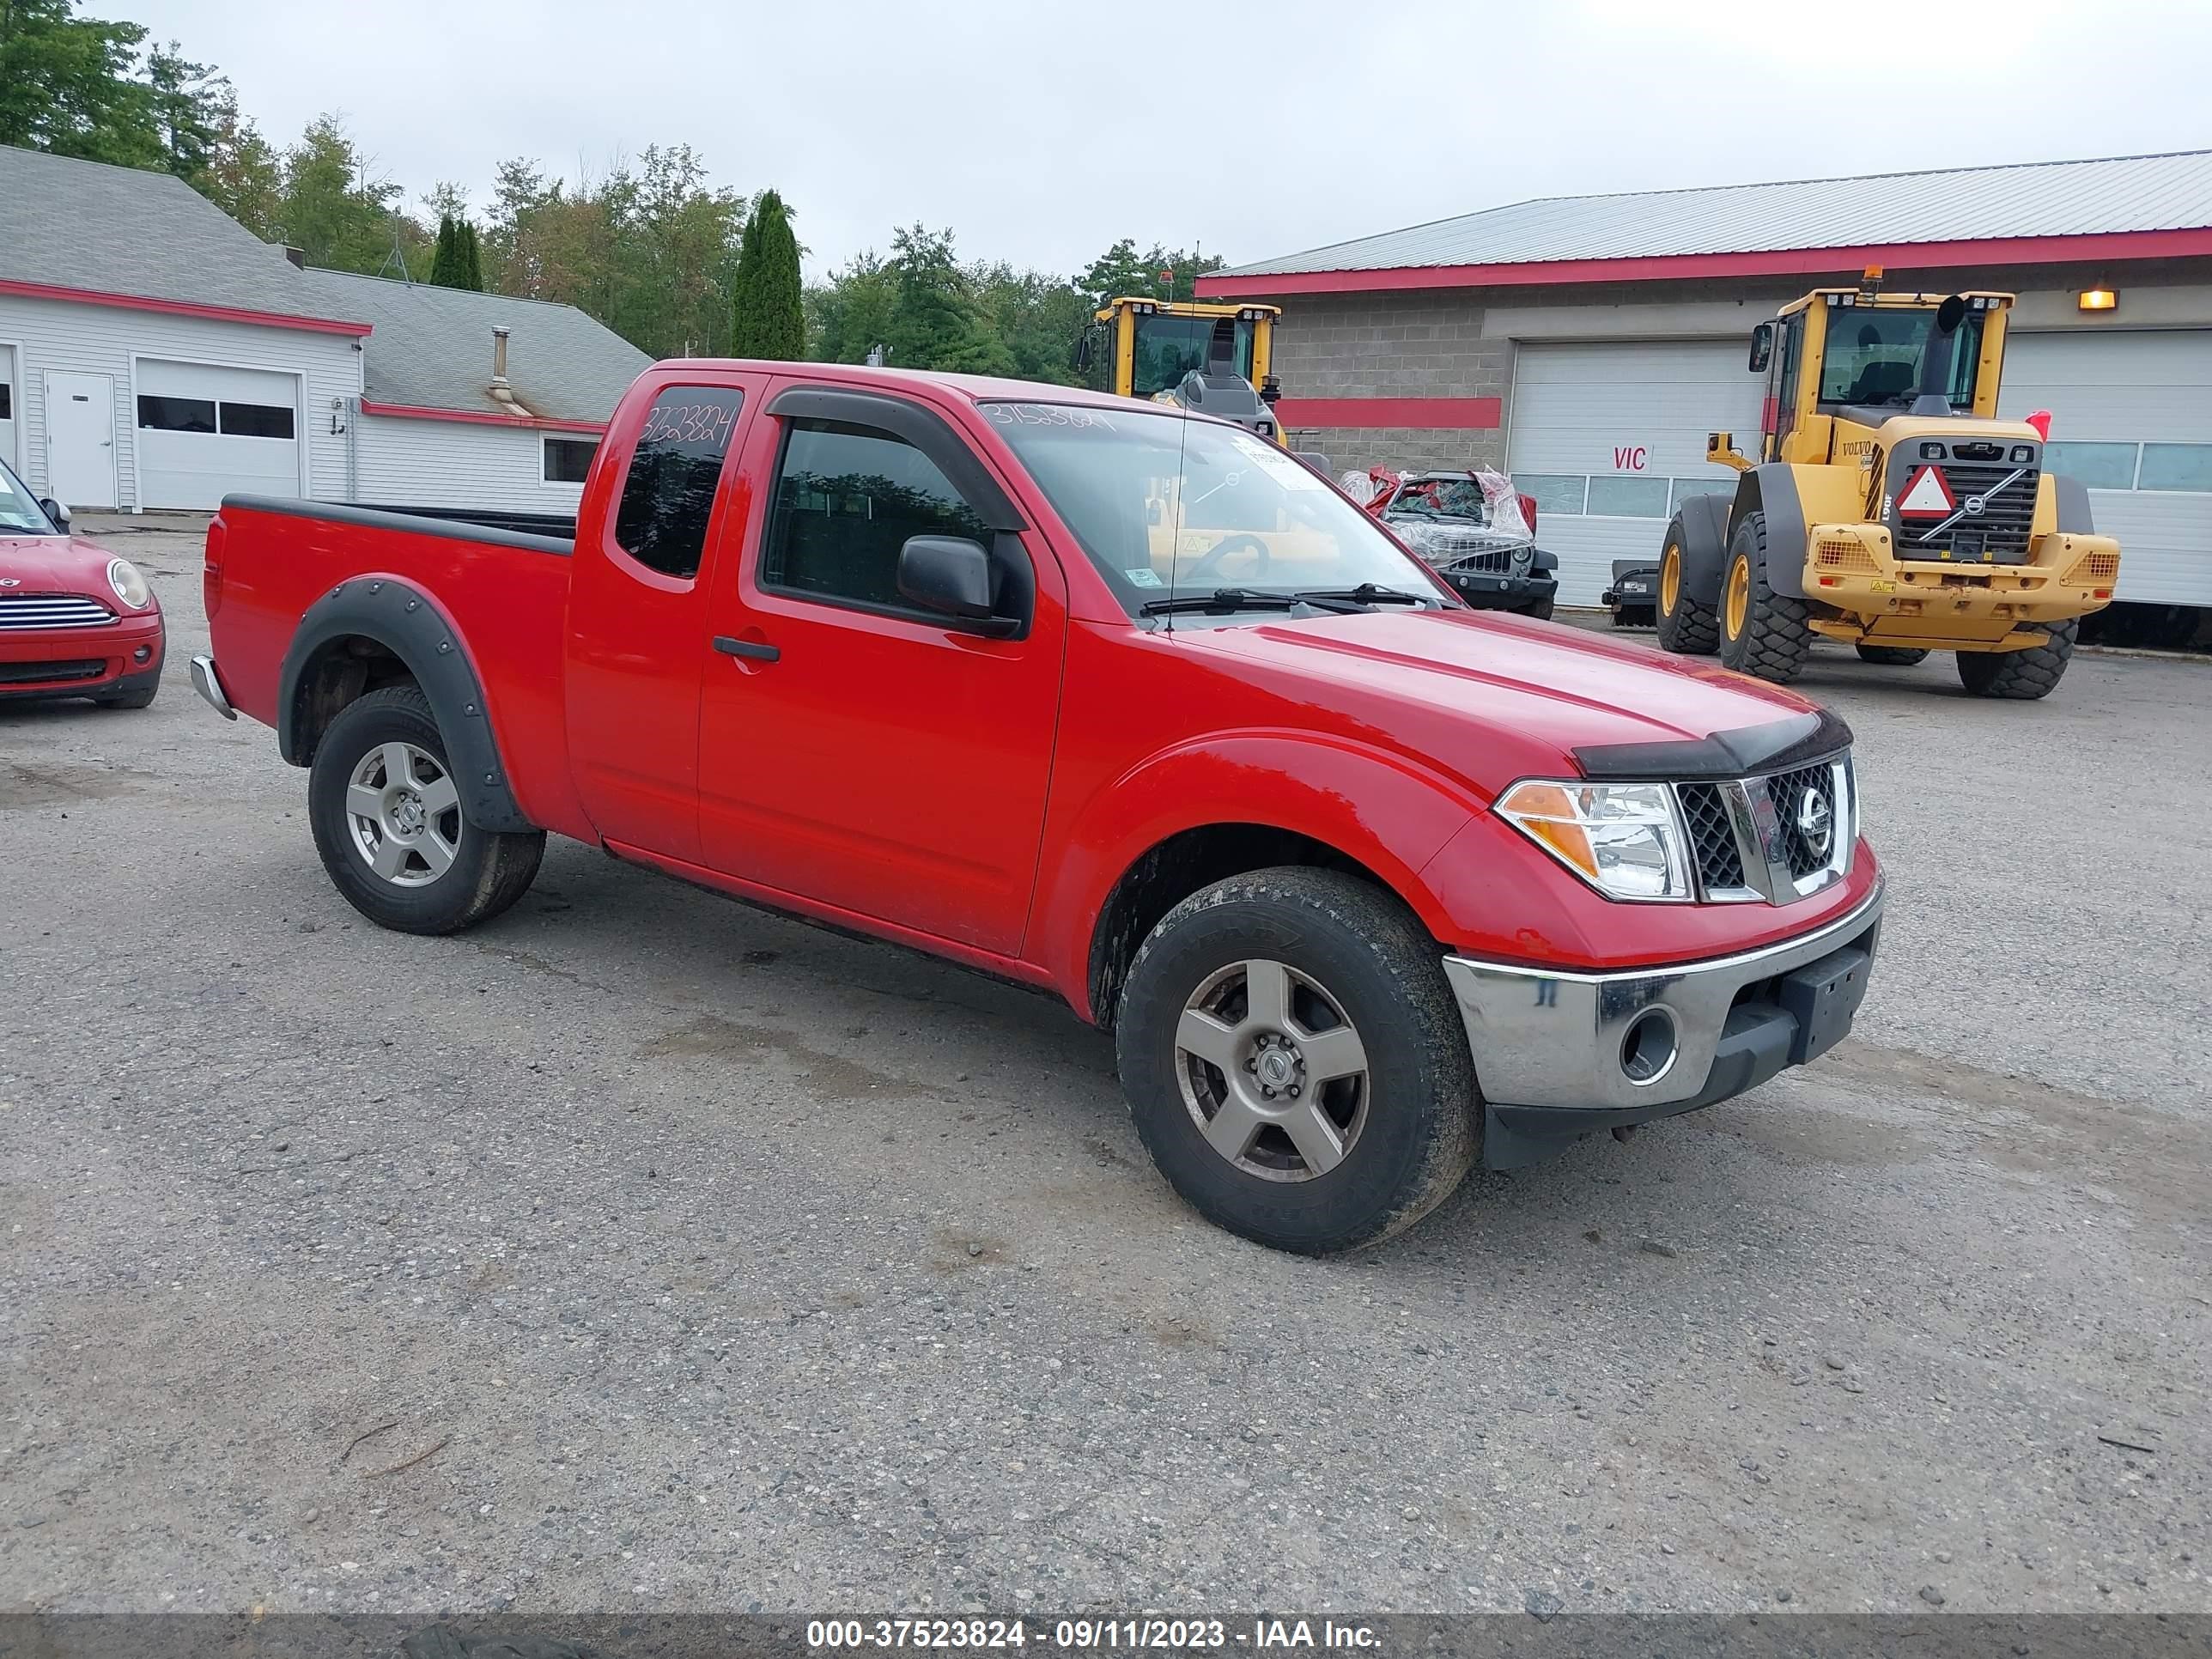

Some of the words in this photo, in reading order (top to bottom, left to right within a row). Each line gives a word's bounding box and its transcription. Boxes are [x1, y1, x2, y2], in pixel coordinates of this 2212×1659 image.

[639, 404, 737, 448] 37523824
[1614, 447, 1646, 471] VIC
[1843, 441, 1871, 456] VOLVO
[1881, 494, 1893, 521] L90F
